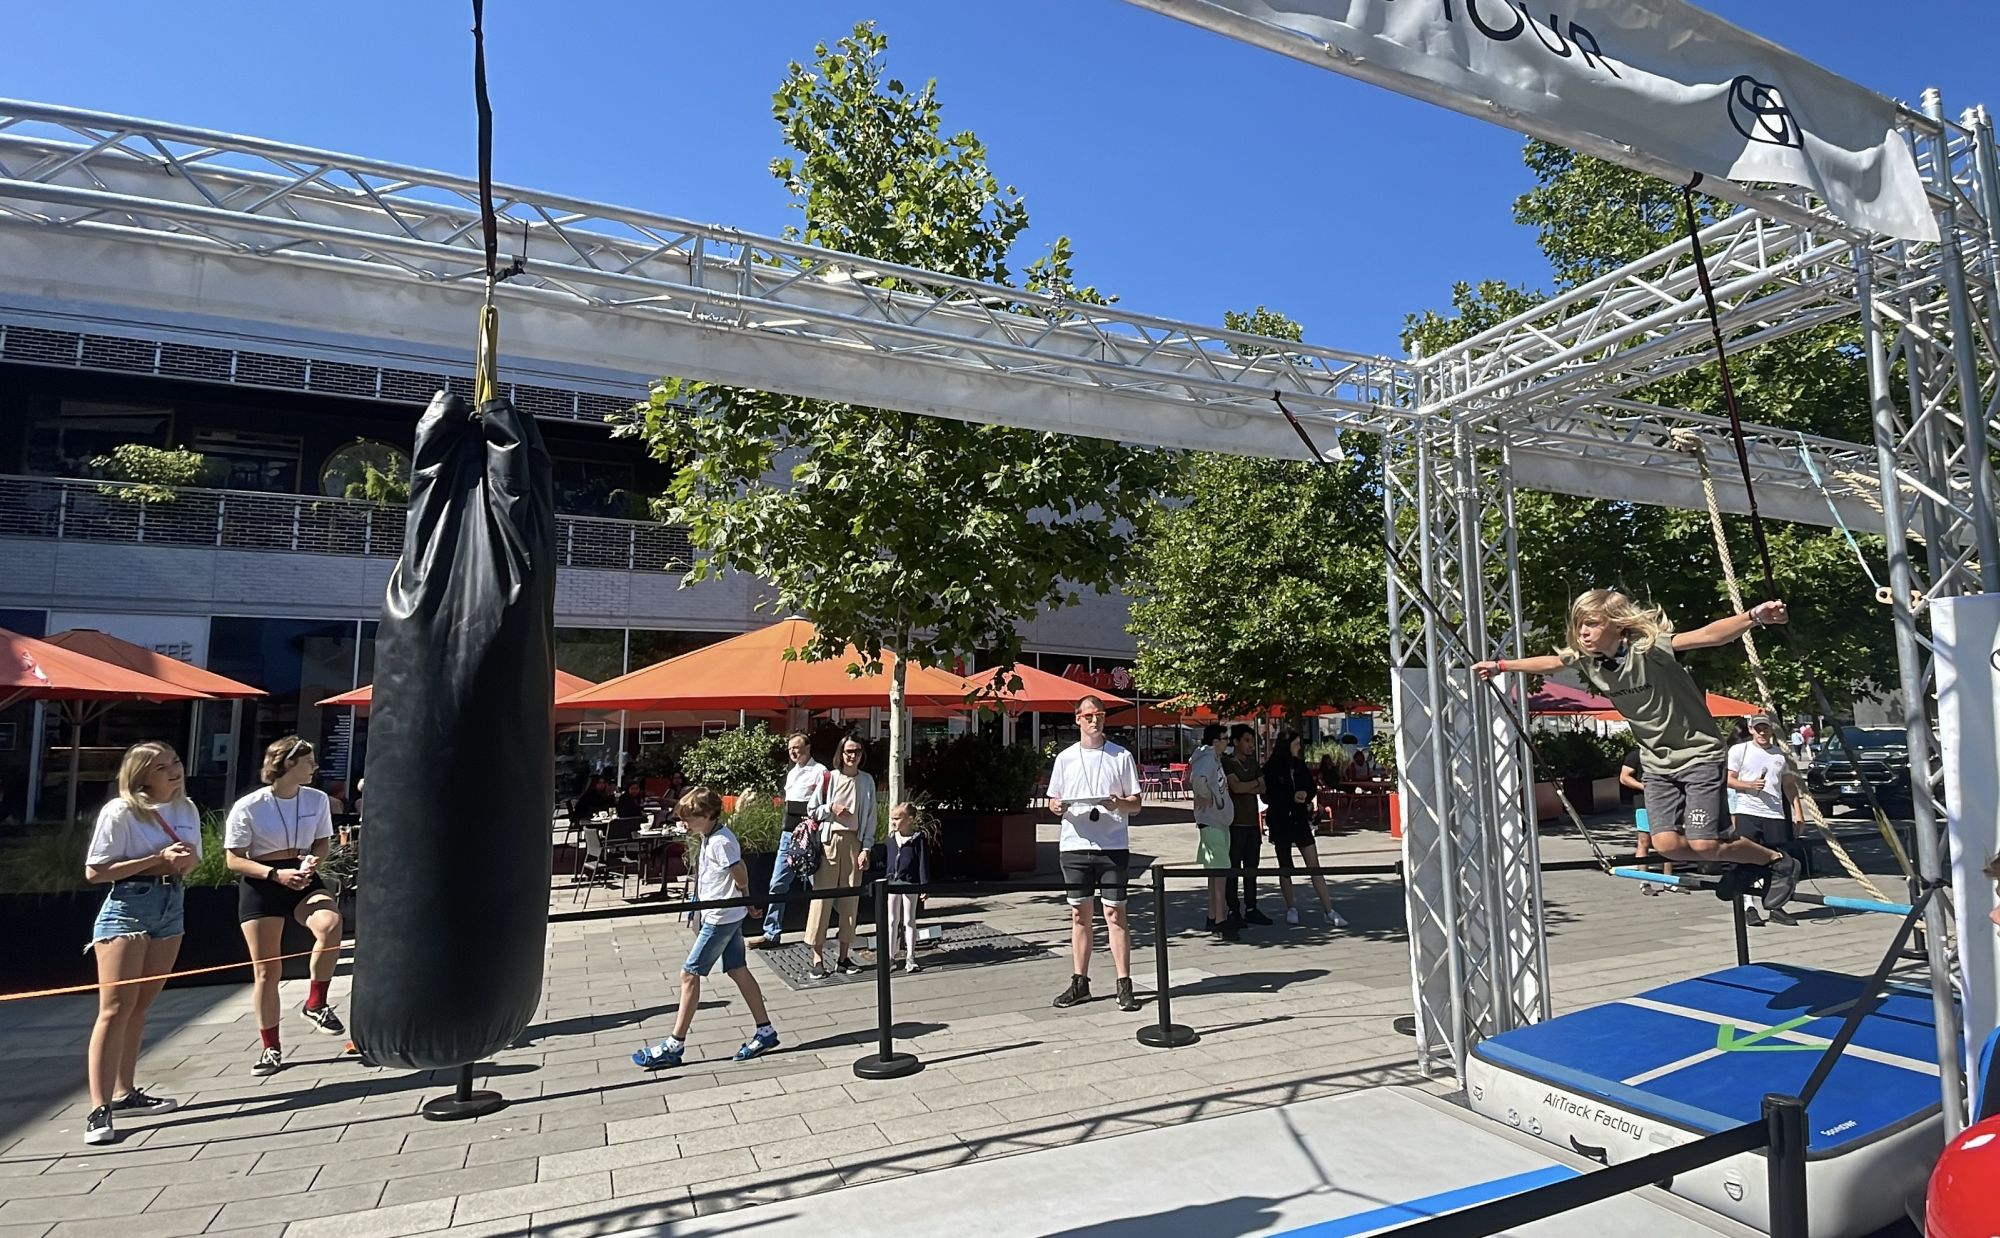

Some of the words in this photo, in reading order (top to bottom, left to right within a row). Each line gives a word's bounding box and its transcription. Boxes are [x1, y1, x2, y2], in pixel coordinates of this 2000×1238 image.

[1692, 813, 1706, 822] NY
[1543, 1092, 1592, 1120] AirTrack
[1594, 1109, 1644, 1141] Factory
